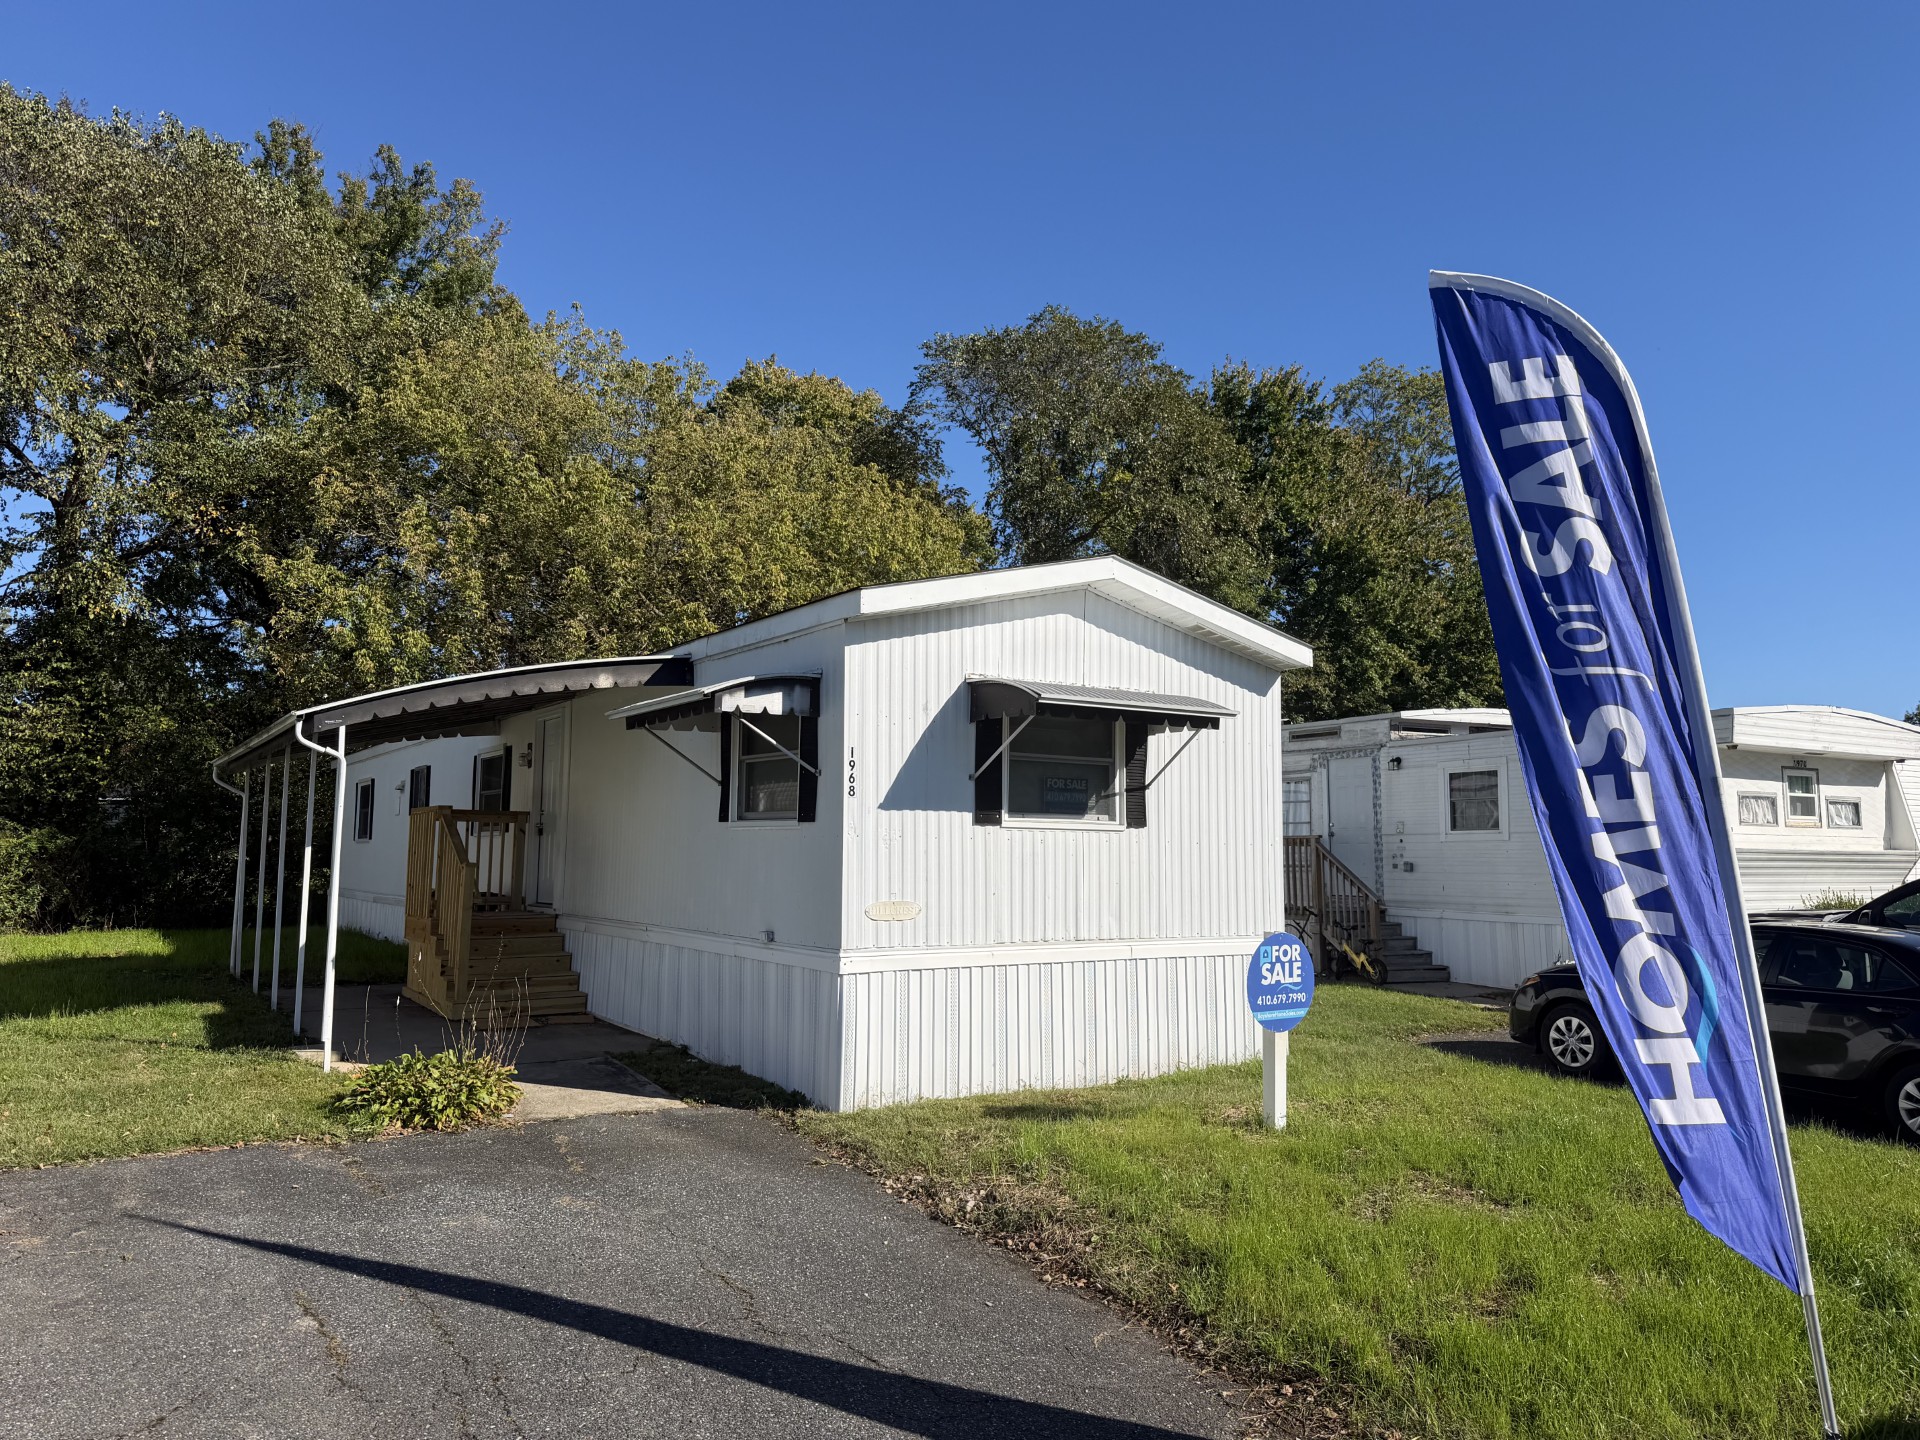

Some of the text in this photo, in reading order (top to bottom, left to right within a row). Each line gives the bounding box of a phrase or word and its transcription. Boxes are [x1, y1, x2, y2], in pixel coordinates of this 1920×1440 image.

[1489, 354, 1727, 1126] HOMES for SALE
[848, 746, 856, 797] 1968
[1047, 778, 1087, 790] FOR SALE
[1272, 944, 1301, 962] FOR
[1261, 962, 1302, 985] SALE
[1257, 992, 1306, 1005] 410.679.7990
